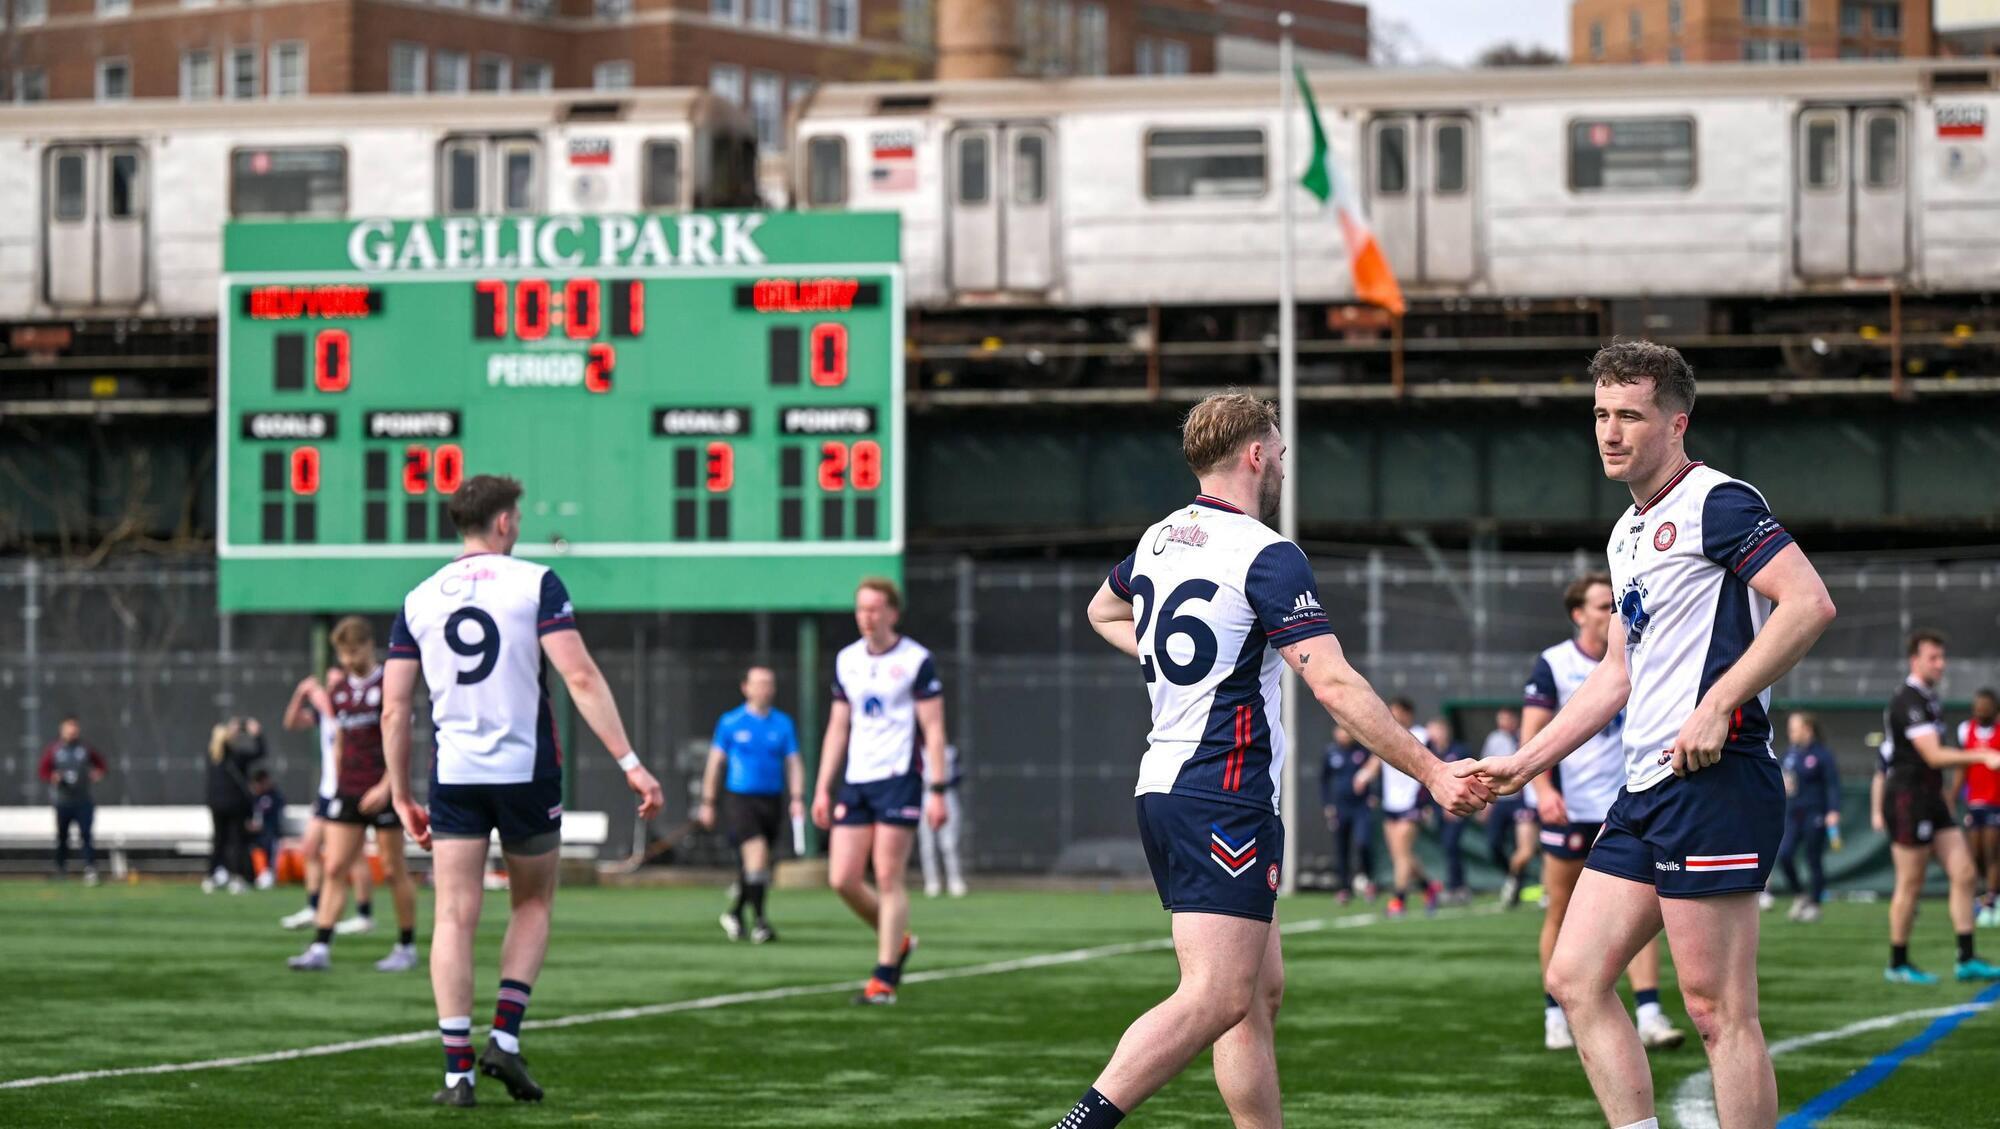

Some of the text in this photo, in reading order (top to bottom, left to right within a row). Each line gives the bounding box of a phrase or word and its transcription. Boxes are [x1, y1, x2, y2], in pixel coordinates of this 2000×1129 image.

[347, 212, 766, 272] GAELIC PARK
[475, 278, 645, 340] 70:01
[315, 329, 350, 391] 0
[487, 352, 585, 387] PERIOD
[585, 342, 616, 393] 2
[810, 322, 848, 386] 0
[291, 446, 319, 495] 0
[403, 444, 463, 494] 20
[706, 441, 734, 492] 3
[818, 440, 881, 491] 28
[1130, 574, 1218, 687] 26
[1282, 612, 1304, 623] Metro
[444, 606, 500, 685] 9
[1655, 860, 1681, 872] oneills
